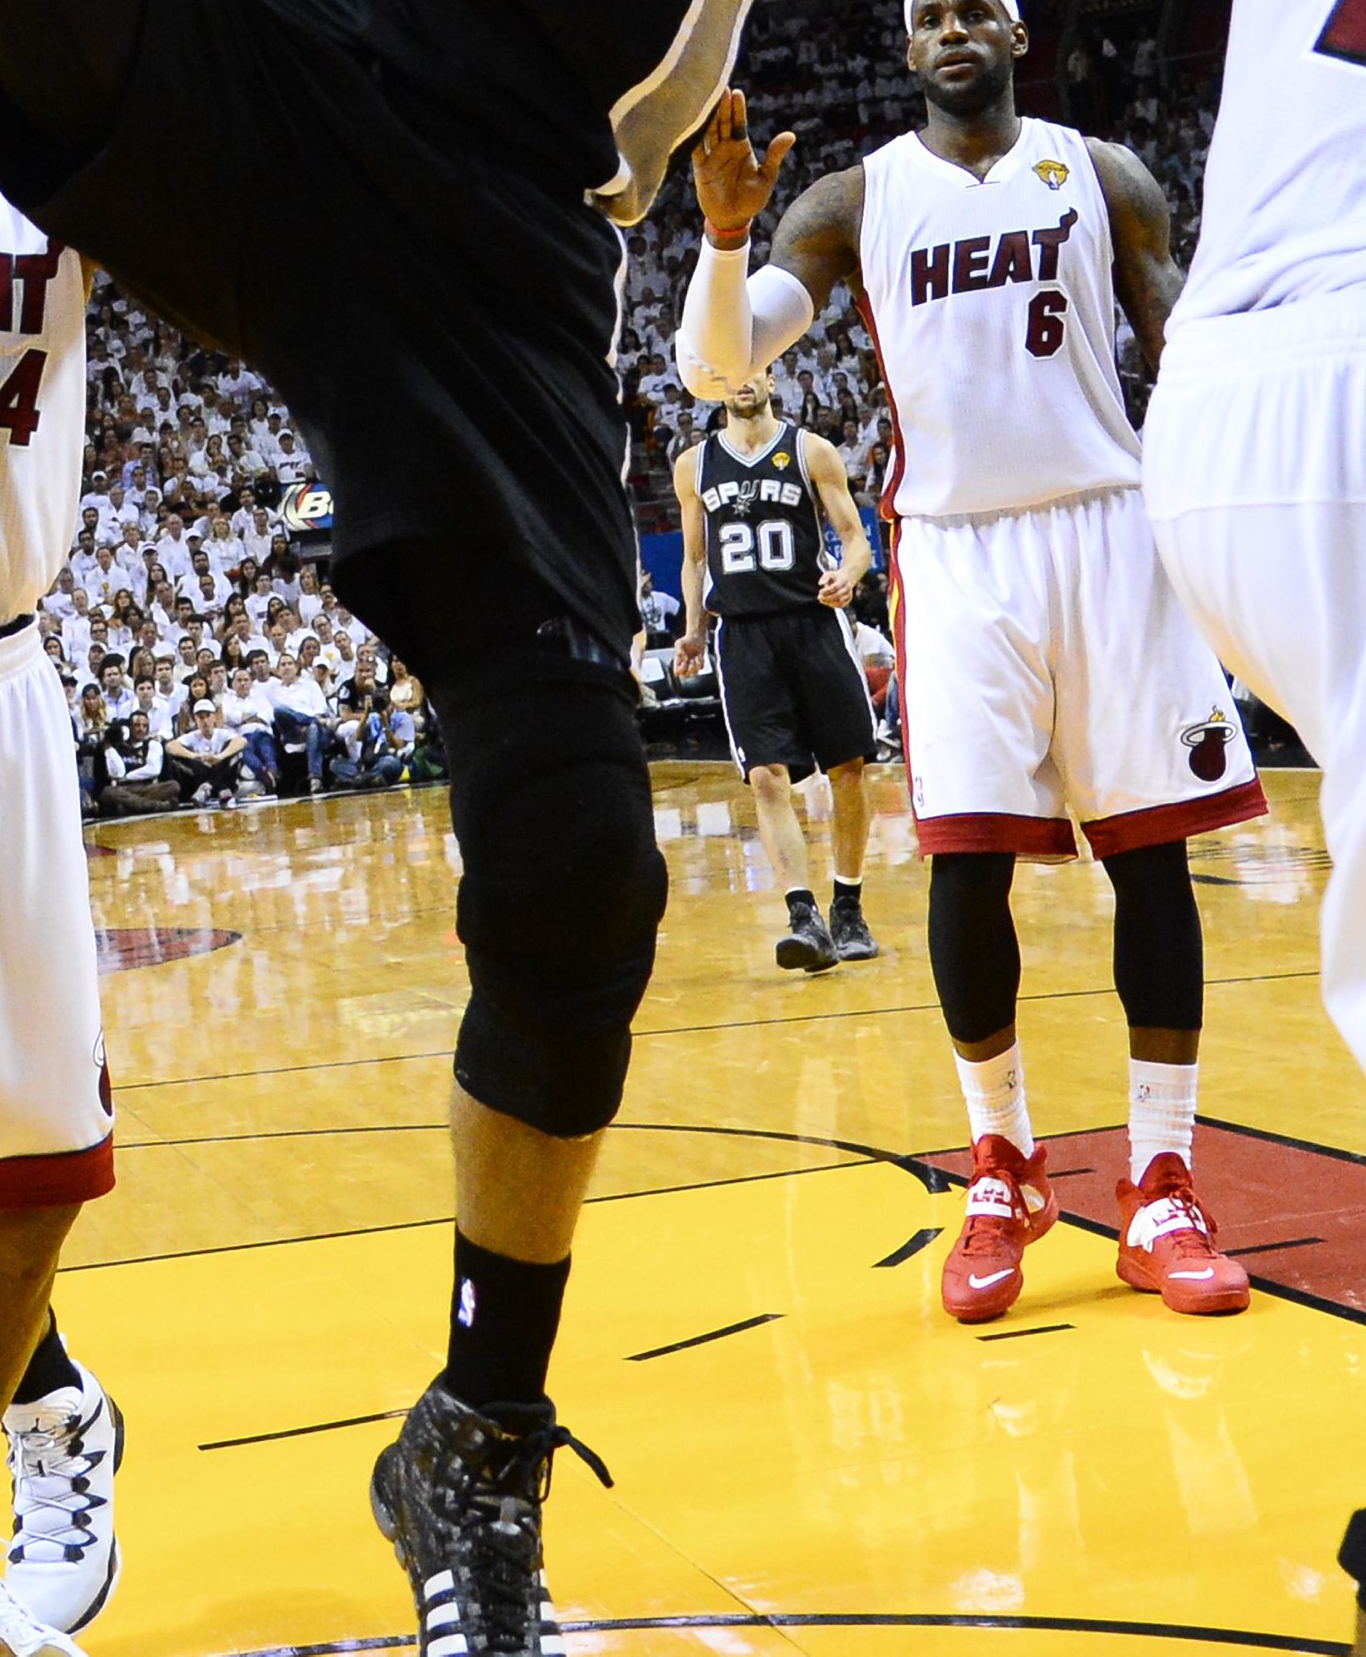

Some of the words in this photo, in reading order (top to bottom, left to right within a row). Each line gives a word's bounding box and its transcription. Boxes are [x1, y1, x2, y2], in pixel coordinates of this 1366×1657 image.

[911, 206, 1079, 307] HEAT
[1026, 289, 1068, 360] 6
[701, 479, 803, 517] SPURS
[719, 519, 796, 575] 20
